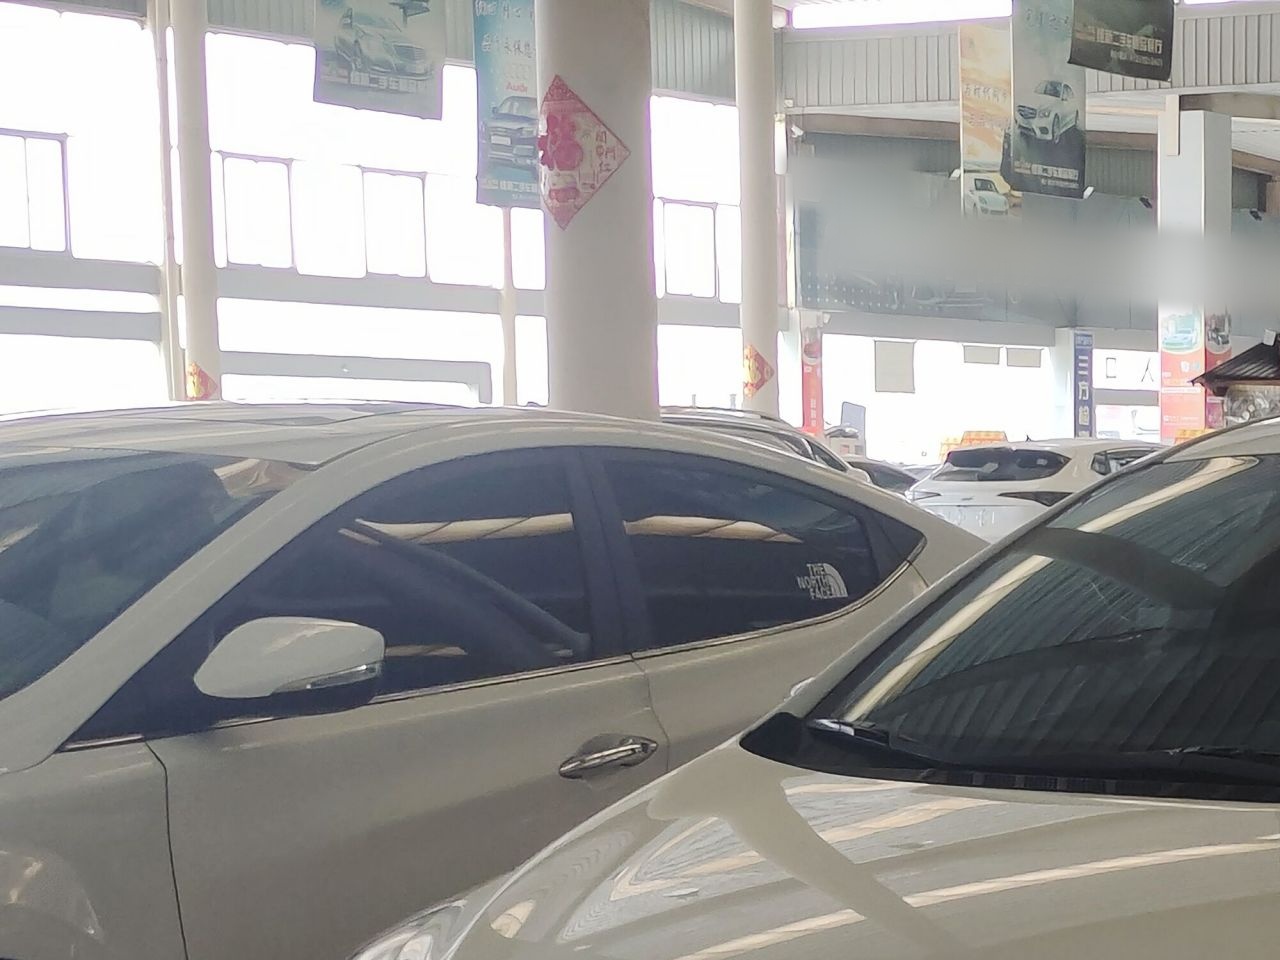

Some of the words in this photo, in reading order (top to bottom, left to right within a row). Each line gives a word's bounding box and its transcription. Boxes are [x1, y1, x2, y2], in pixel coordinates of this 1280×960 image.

[806, 563, 825, 575] THE
[796, 575, 830, 589] NORTH
[809, 586, 833, 600] FACE
